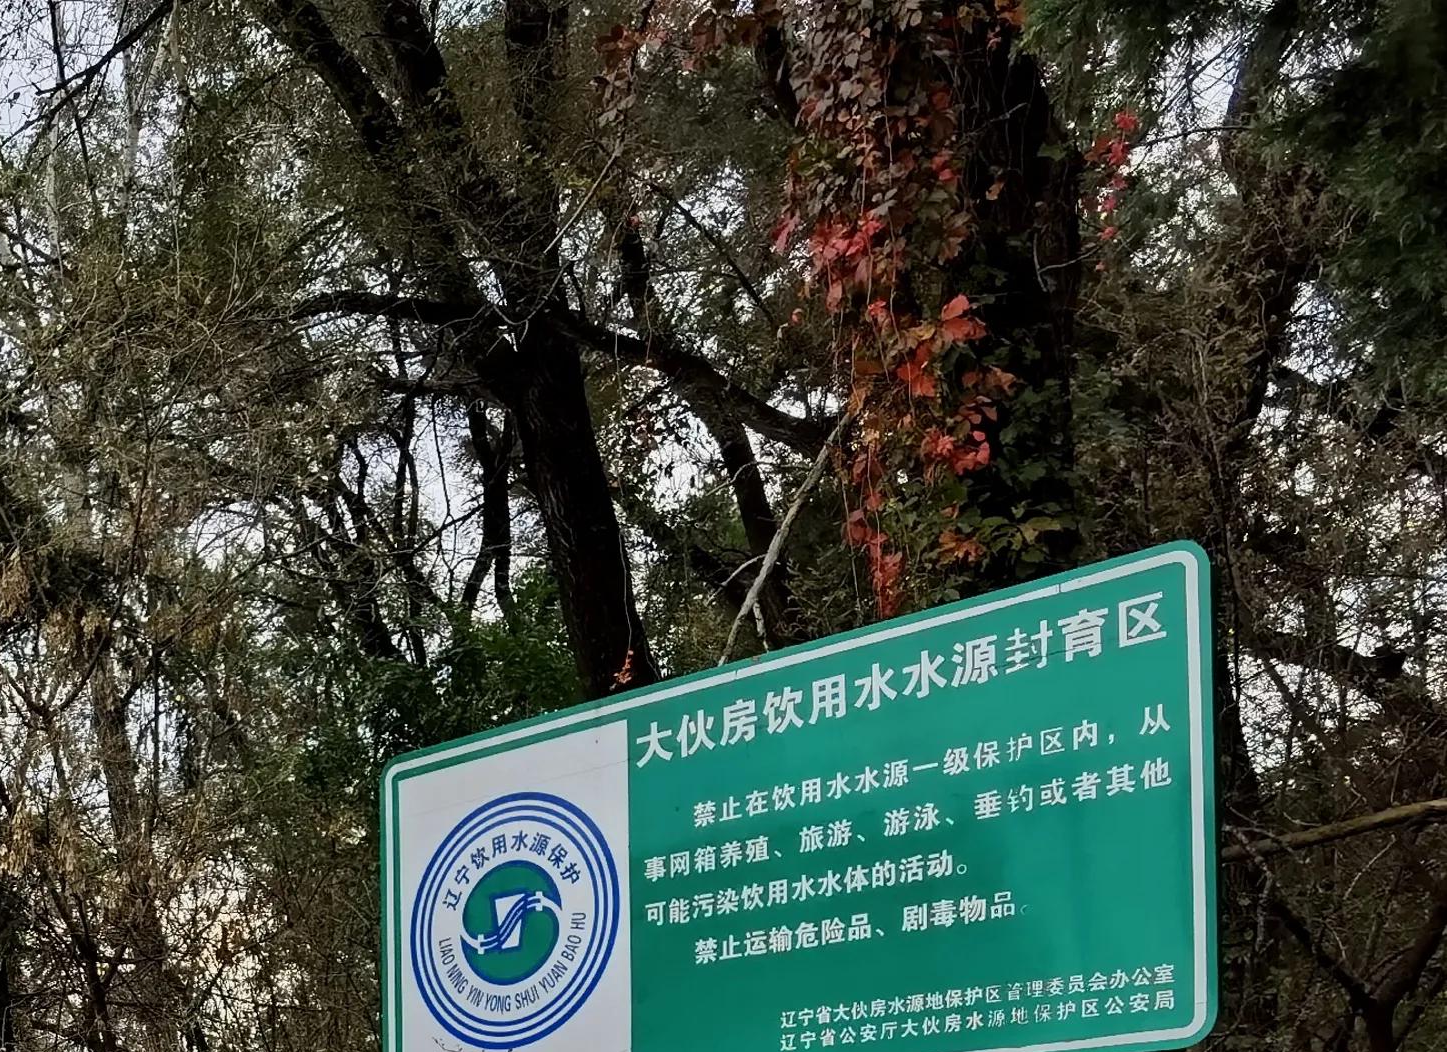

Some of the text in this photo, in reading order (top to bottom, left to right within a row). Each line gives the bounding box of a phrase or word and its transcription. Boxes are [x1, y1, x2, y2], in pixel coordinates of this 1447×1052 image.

[635, 591, 1167, 768] 大伙房饮用水水源封育区
[442, 830, 581, 911] 辽宁饮用水源保护
[645, 849, 968, 926] 可能污染饮用水水体的活动。
[438, 912, 587, 1015] LIAO NING YIN YONG SHUI YUAN BAO HU
[780, 963, 1175, 1029] 辽宁省大伙房水源地保护区管理委员会办公室
[779, 989, 1175, 1052] 辽宁省公安厅大伙房水源地保护区公安局
